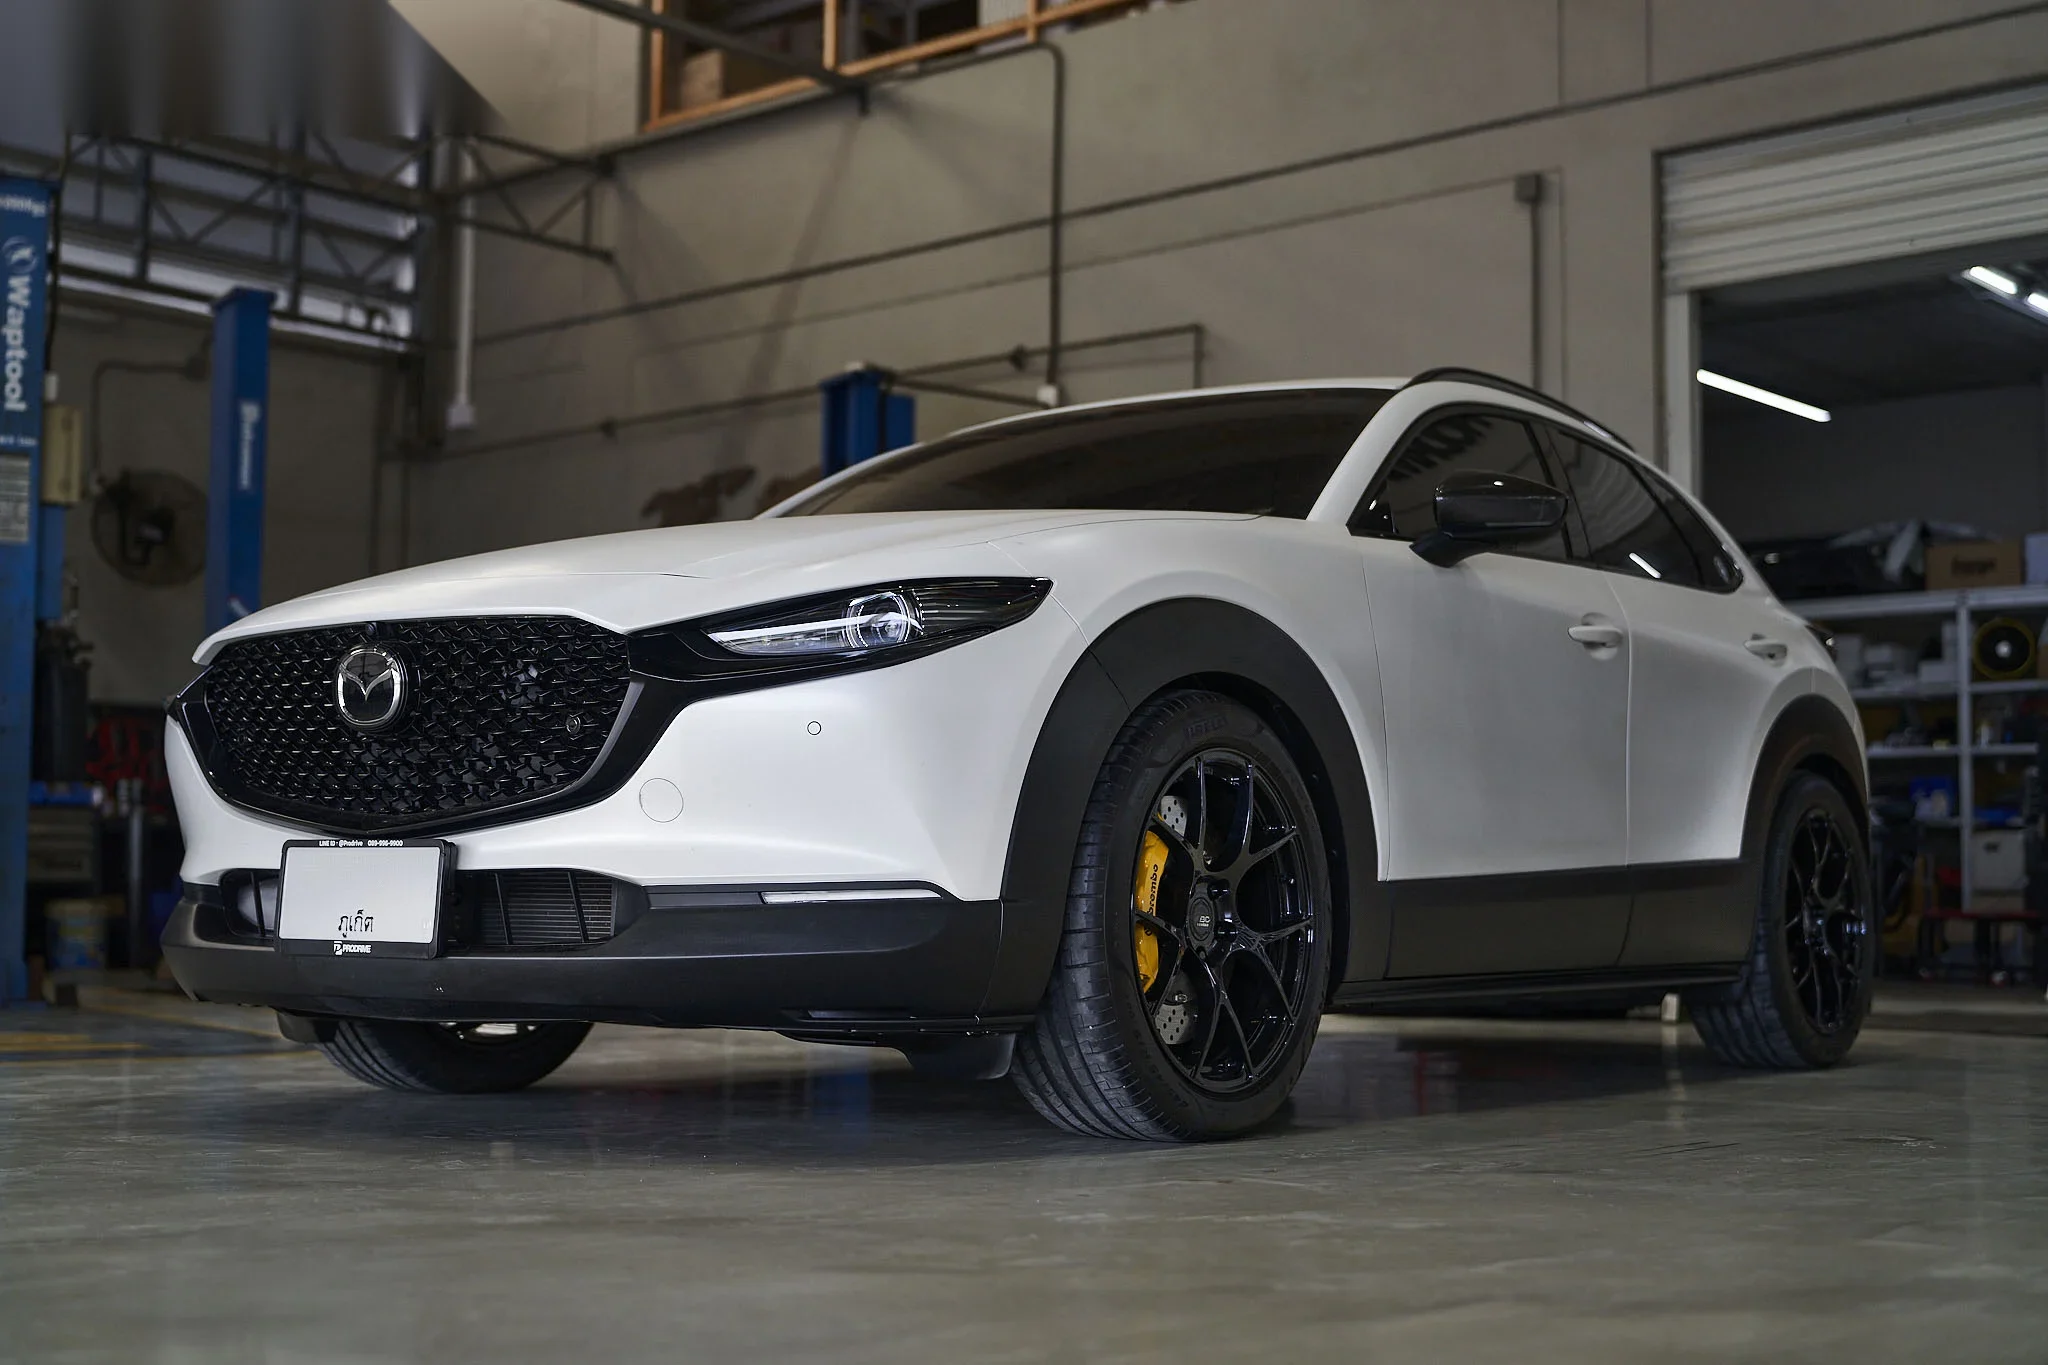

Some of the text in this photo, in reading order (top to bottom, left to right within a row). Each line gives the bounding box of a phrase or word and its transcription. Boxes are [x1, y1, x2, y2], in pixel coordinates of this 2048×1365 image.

[3, 275, 31, 412] Waptool
[338, 909, 374, 938] ภูเก็ต
[342, 944, 371, 953] PRODRIVE
